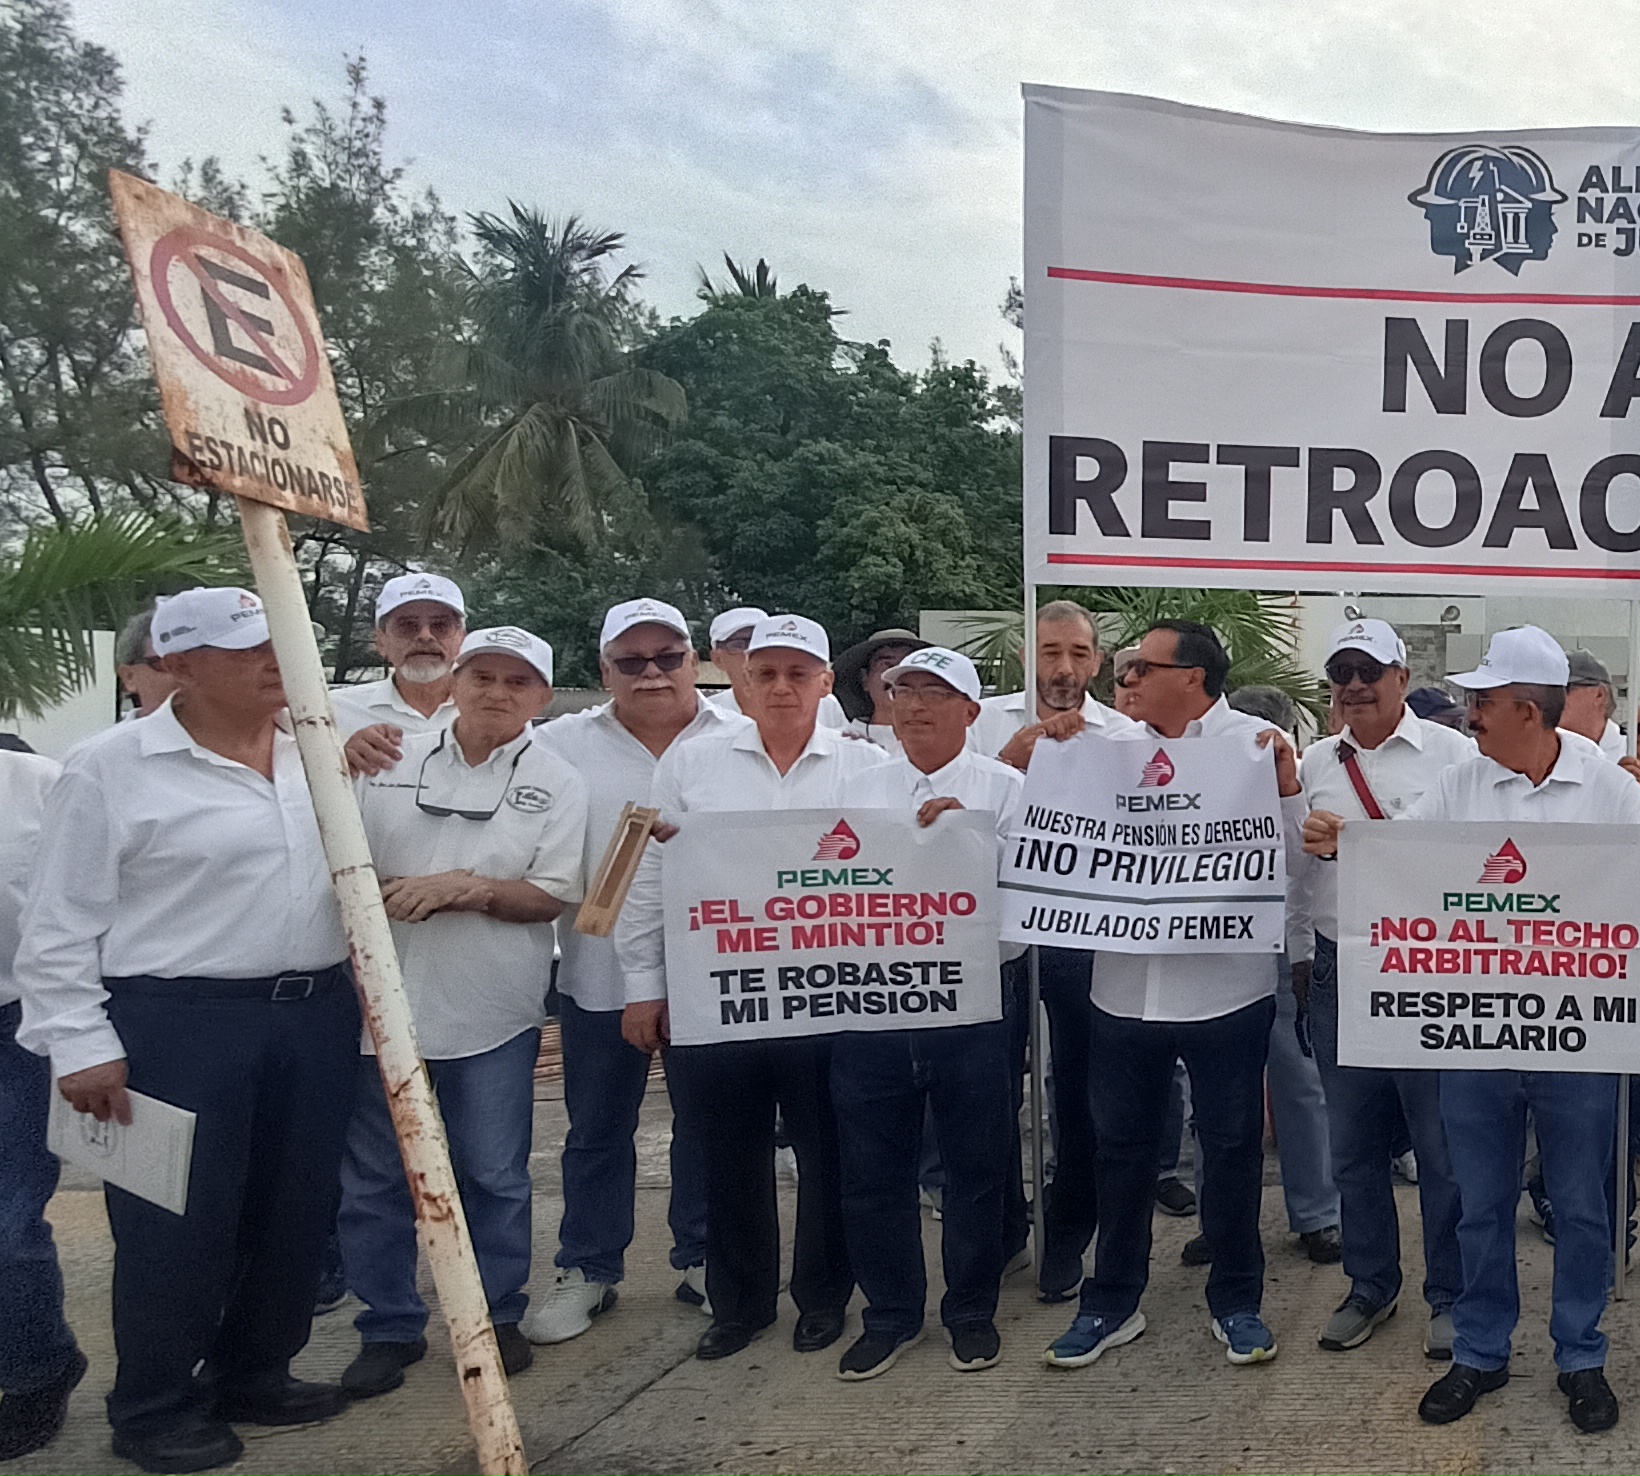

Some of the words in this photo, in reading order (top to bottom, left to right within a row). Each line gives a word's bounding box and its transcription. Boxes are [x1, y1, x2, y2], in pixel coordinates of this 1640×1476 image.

[1577, 232, 1607, 249] DE
[1382, 314, 1575, 419] NO
[244, 408, 291, 450] NO
[187, 431, 358, 510] ESTACIONARSE
[765, 631, 806, 644] PEMEX
[911, 652, 954, 670] CFE
[1116, 792, 1202, 812] PEMEX
[1024, 805, 1106, 842] NUESTRA
[1112, 818, 1177, 847] PENSIÓN
[1182, 823, 1200, 845] ES
[1204, 816, 1281, 844] DERECHO,
[777, 867, 894, 889] PEMEX
[1014, 837, 1079, 876] ¡NO
[1088, 847, 1276, 886] PRIVILEGIO!
[689, 899, 754, 931] ¡EL
[764, 892, 977, 922] GOBIERNO
[1443, 892, 1561, 913] PEMEX
[716, 926, 780, 953] ME
[791, 914, 945, 949] MINTIÓ!
[1021, 906, 1160, 941] JUBILADOS
[1168, 915, 1254, 940] PEMEX
[1370, 917, 1438, 947] ¡NO
[1447, 919, 1499, 943] AL
[1507, 919, 1640, 949] TECHO
[710, 968, 766, 995] TE
[778, 961, 963, 990] ROBASTE
[1380, 947, 1628, 980] ARBITRARIO!
[720, 997, 769, 1025] MI
[783, 984, 957, 1019] PENSIÓN
[1370, 991, 1546, 1020] RESPETO
[1555, 995, 1584, 1021] A
[1593, 996, 1638, 1024] MI
[1420, 1024, 1588, 1052] SALARIO
